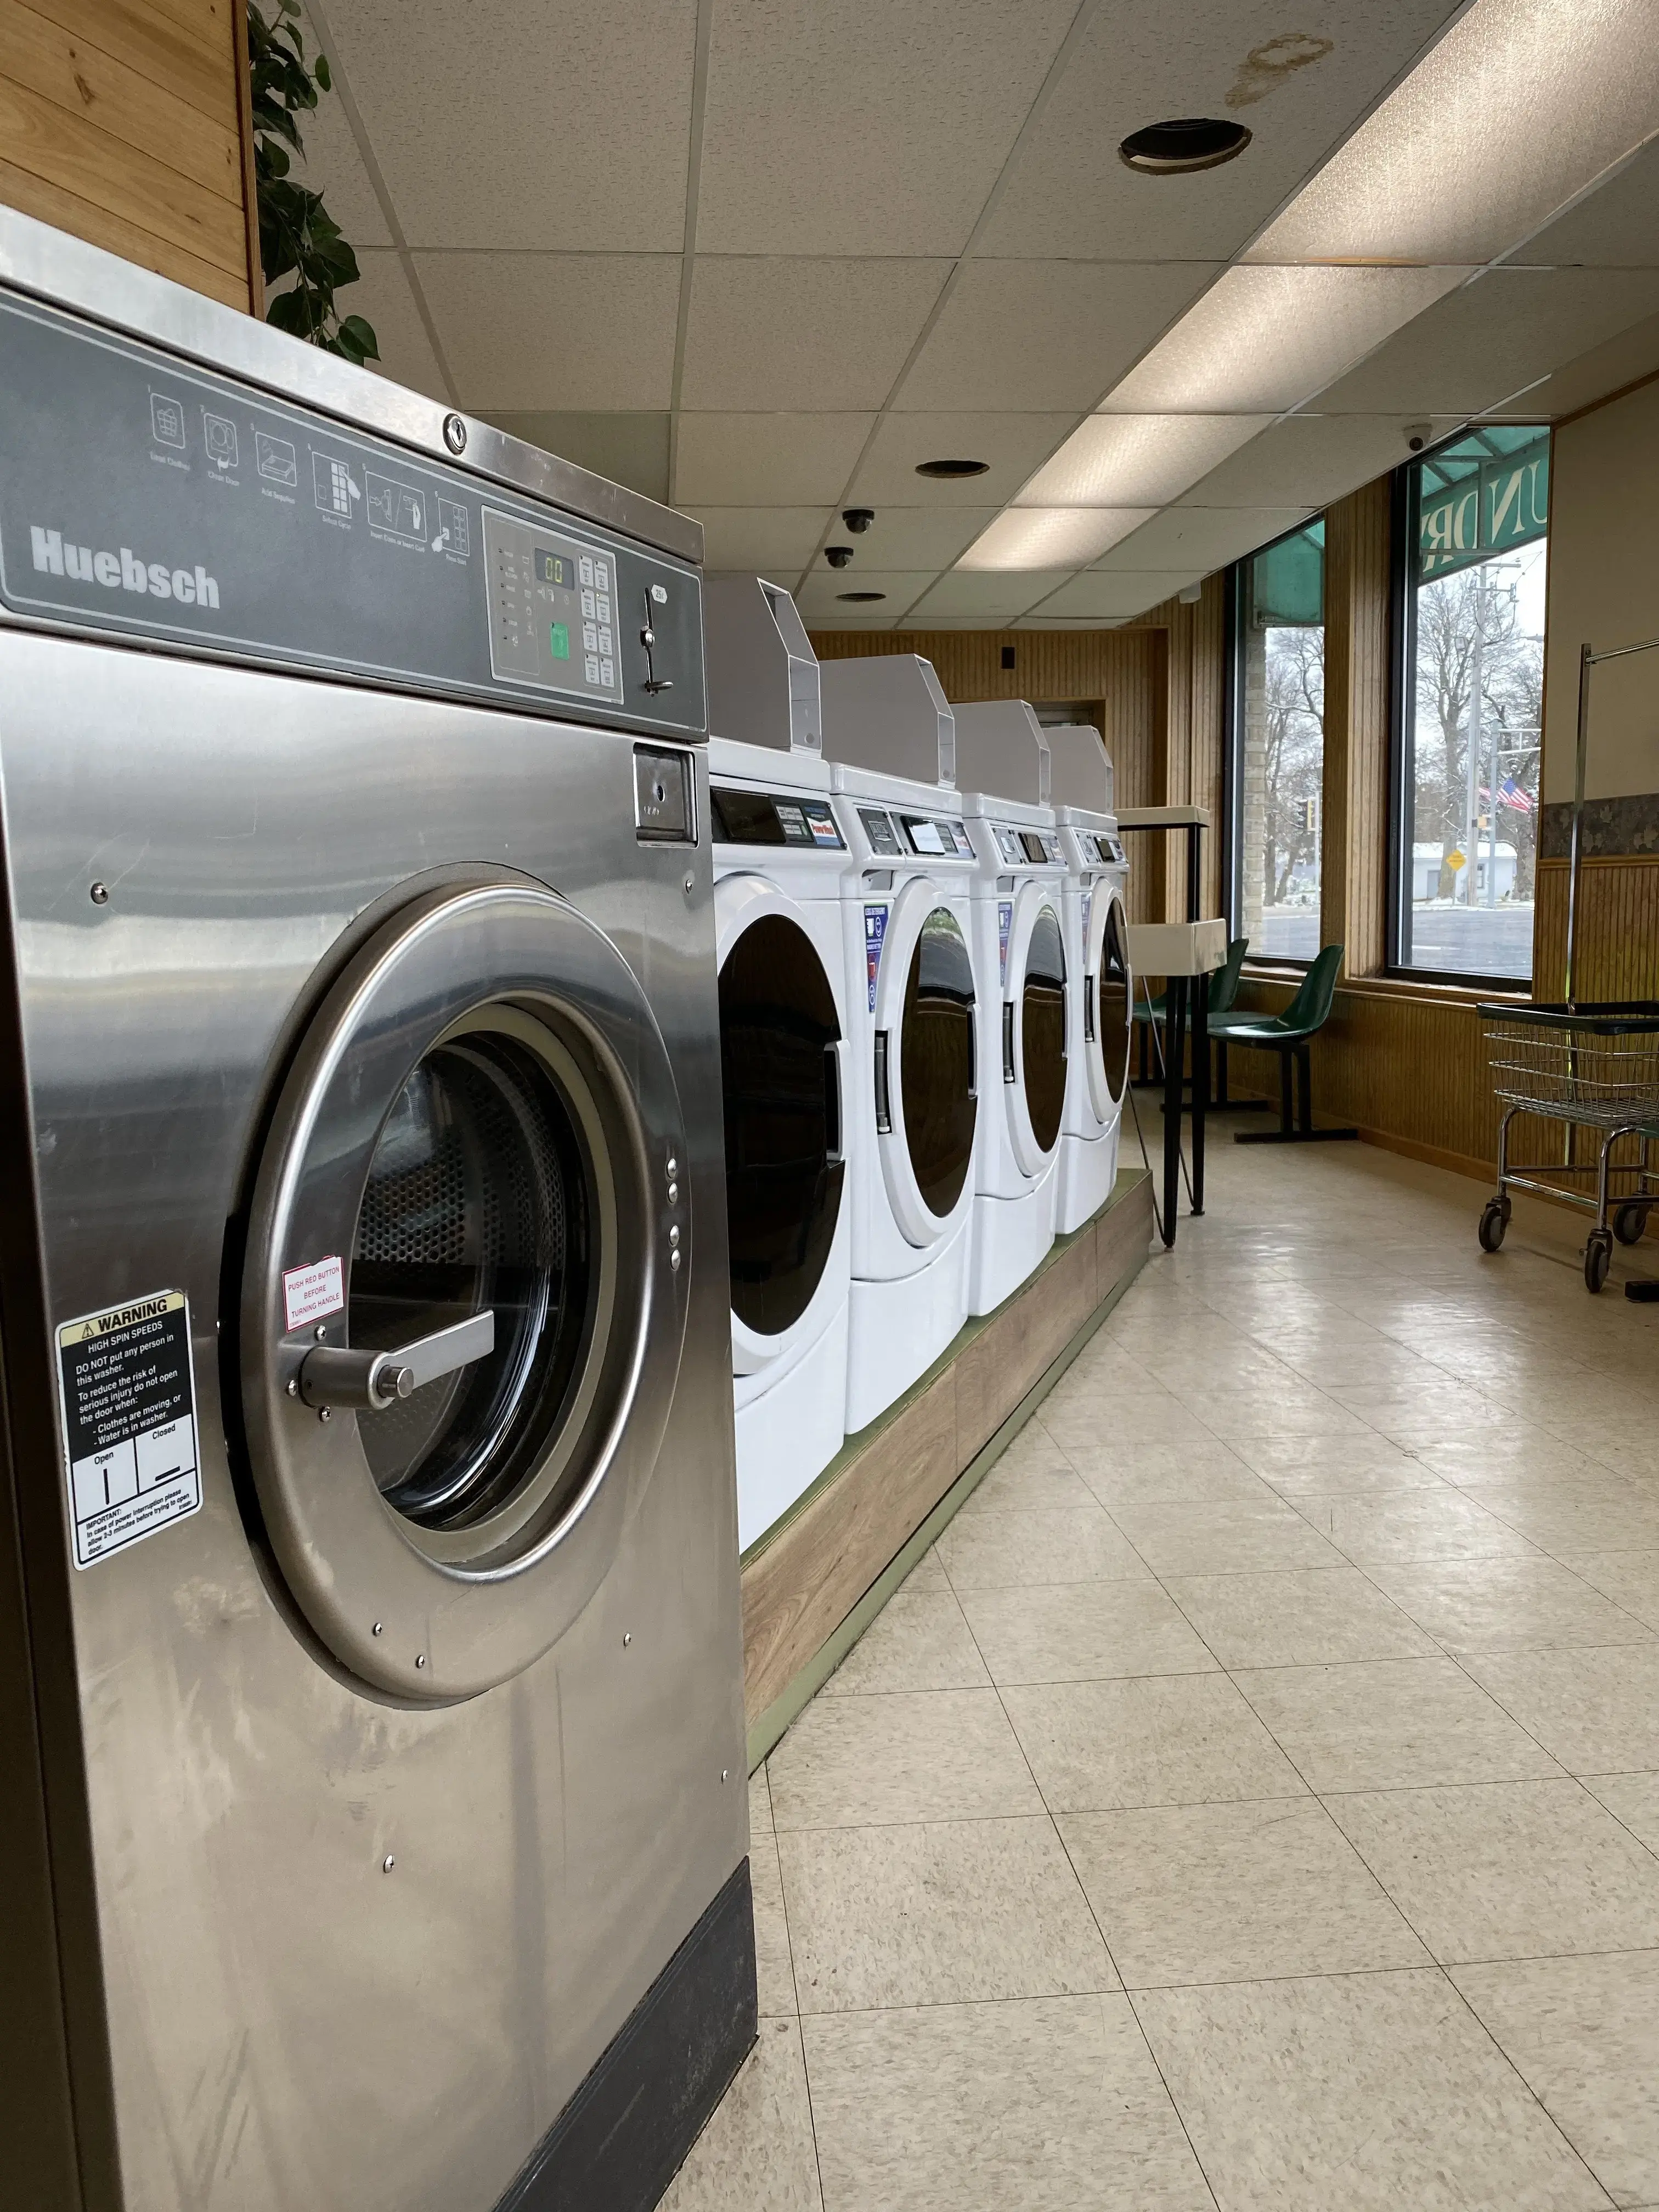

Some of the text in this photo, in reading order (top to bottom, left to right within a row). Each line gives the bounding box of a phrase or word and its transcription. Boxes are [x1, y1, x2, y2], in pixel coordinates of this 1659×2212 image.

[30, 525, 220, 610] Huebsch
[288, 1266, 340, 1292] PUSH RED BUTTON
[304, 1284, 326, 1300] BEFORE
[98, 1299, 167, 1333] WARNING
[292, 1293, 340, 1318] TURNING HANDLE
[88, 1321, 163, 1353] HIGH SPIN SPEEDS
[76, 1334, 174, 1375] DO NOT put any person in
[77, 1364, 125, 1386] this washer.
[78, 1364, 156, 1402] To reduce the risk of
[79, 1369, 178, 1414] serious injury do not open
[80, 1396, 138, 1425] the door when:
[98, 1415, 128, 1434] Clothes
[129, 1410, 142, 1421] are
[143, 1399, 172, 1415] moving,
[173, 1394, 182, 1403] or
[98, 1430, 121, 1446] Water
[122, 1426, 129, 1435] is
[131, 1423, 138, 1432] in
[139, 1411, 168, 1428] washer.
[153, 1424, 176, 1440] Closed
[94, 1452, 114, 1465] Open
[86, 1509, 122, 1530] IMPORTANT:
[88, 1535, 103, 1547] allow
[104, 1530, 112, 1539] 2-3
[113, 1520, 135, 1534] minutes
[136, 1511, 153, 1523] before
[154, 1502, 170, 1515] trying
[177, 1493, 190, 1504] open
[94, 1525, 107, 1535] case
[115, 1513, 132, 1525] power
[165, 1489, 182, 1502] please
[88, 1543, 103, 1555] door.
